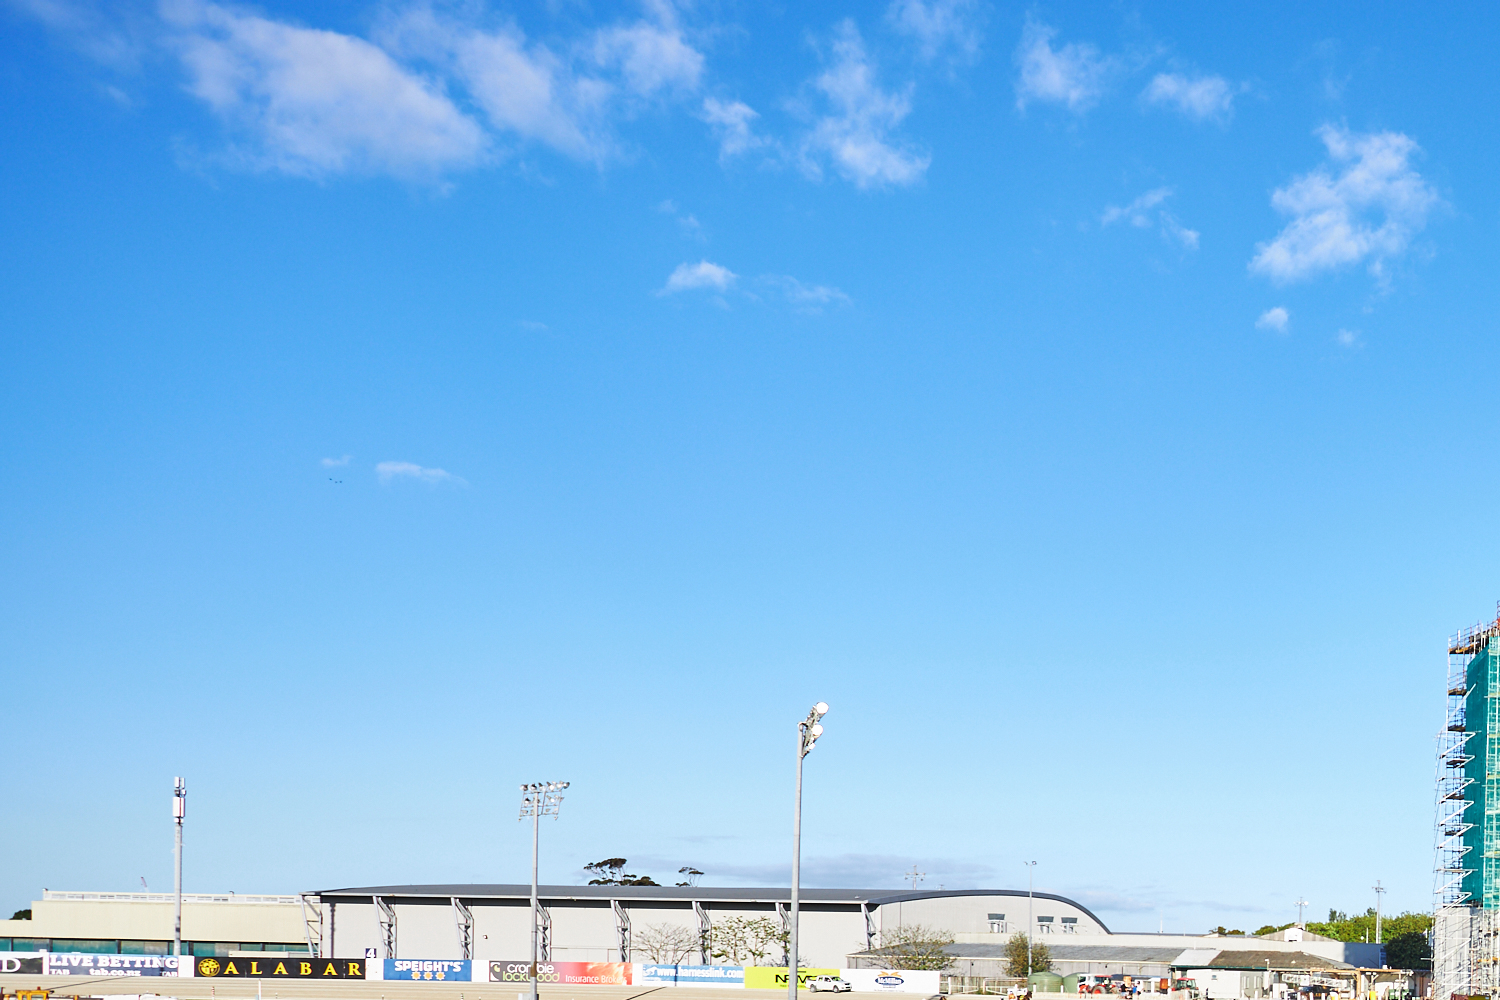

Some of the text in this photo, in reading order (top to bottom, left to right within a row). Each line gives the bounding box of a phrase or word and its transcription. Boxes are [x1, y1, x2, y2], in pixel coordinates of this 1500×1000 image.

[366, 948, 376, 958] 4
[0, 958, 21, 973] D
[49, 955, 179, 969] LIVE BETTING
[394, 961, 462, 973] SPEIGHT'S
[89, 968, 142, 977] tab.co.nz
[223, 961, 363, 976] ALABAR
[507, 963, 555, 974] crobie
[502, 971, 560, 982] lockood
[565, 975, 599, 984] Insurance
